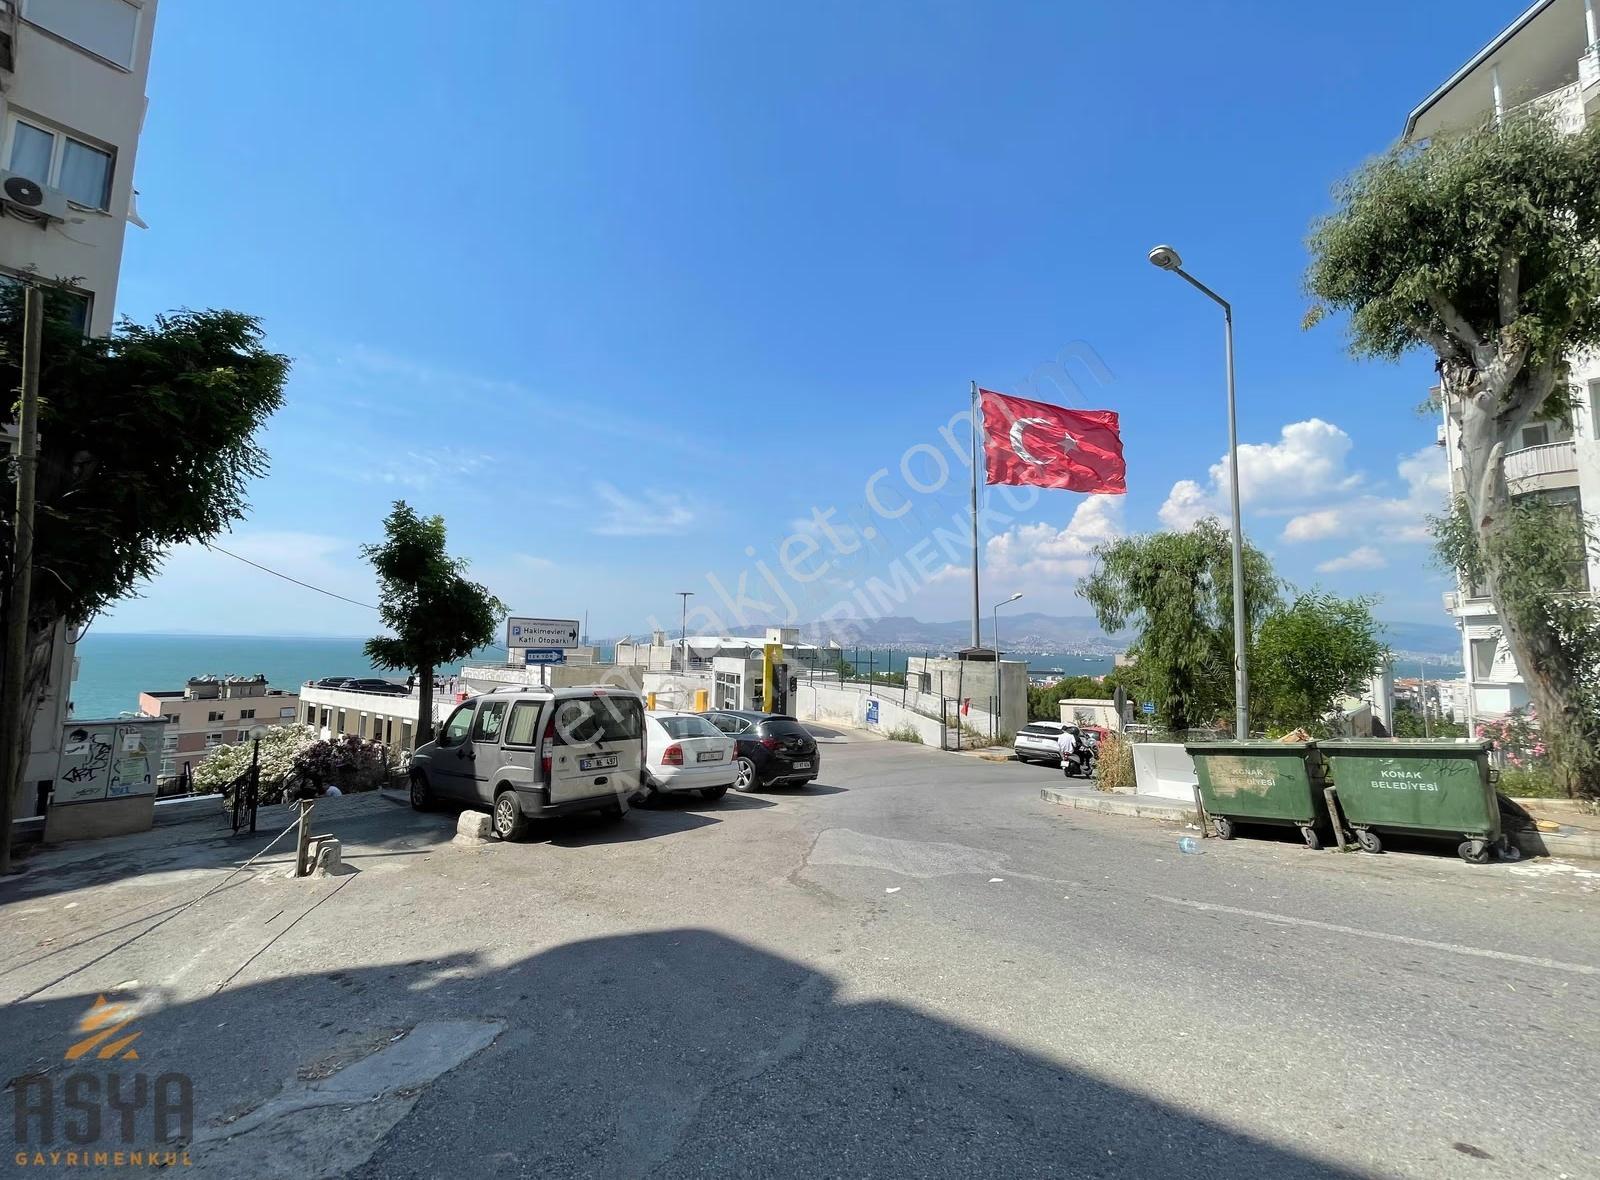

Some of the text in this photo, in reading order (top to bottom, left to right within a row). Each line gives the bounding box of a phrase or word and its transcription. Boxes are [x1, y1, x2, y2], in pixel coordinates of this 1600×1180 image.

[523, 627, 565, 635] Hakimevleri
[1381, 770, 1422, 779] KONAK
[1371, 780, 1439, 792] BELEDİYESİ
